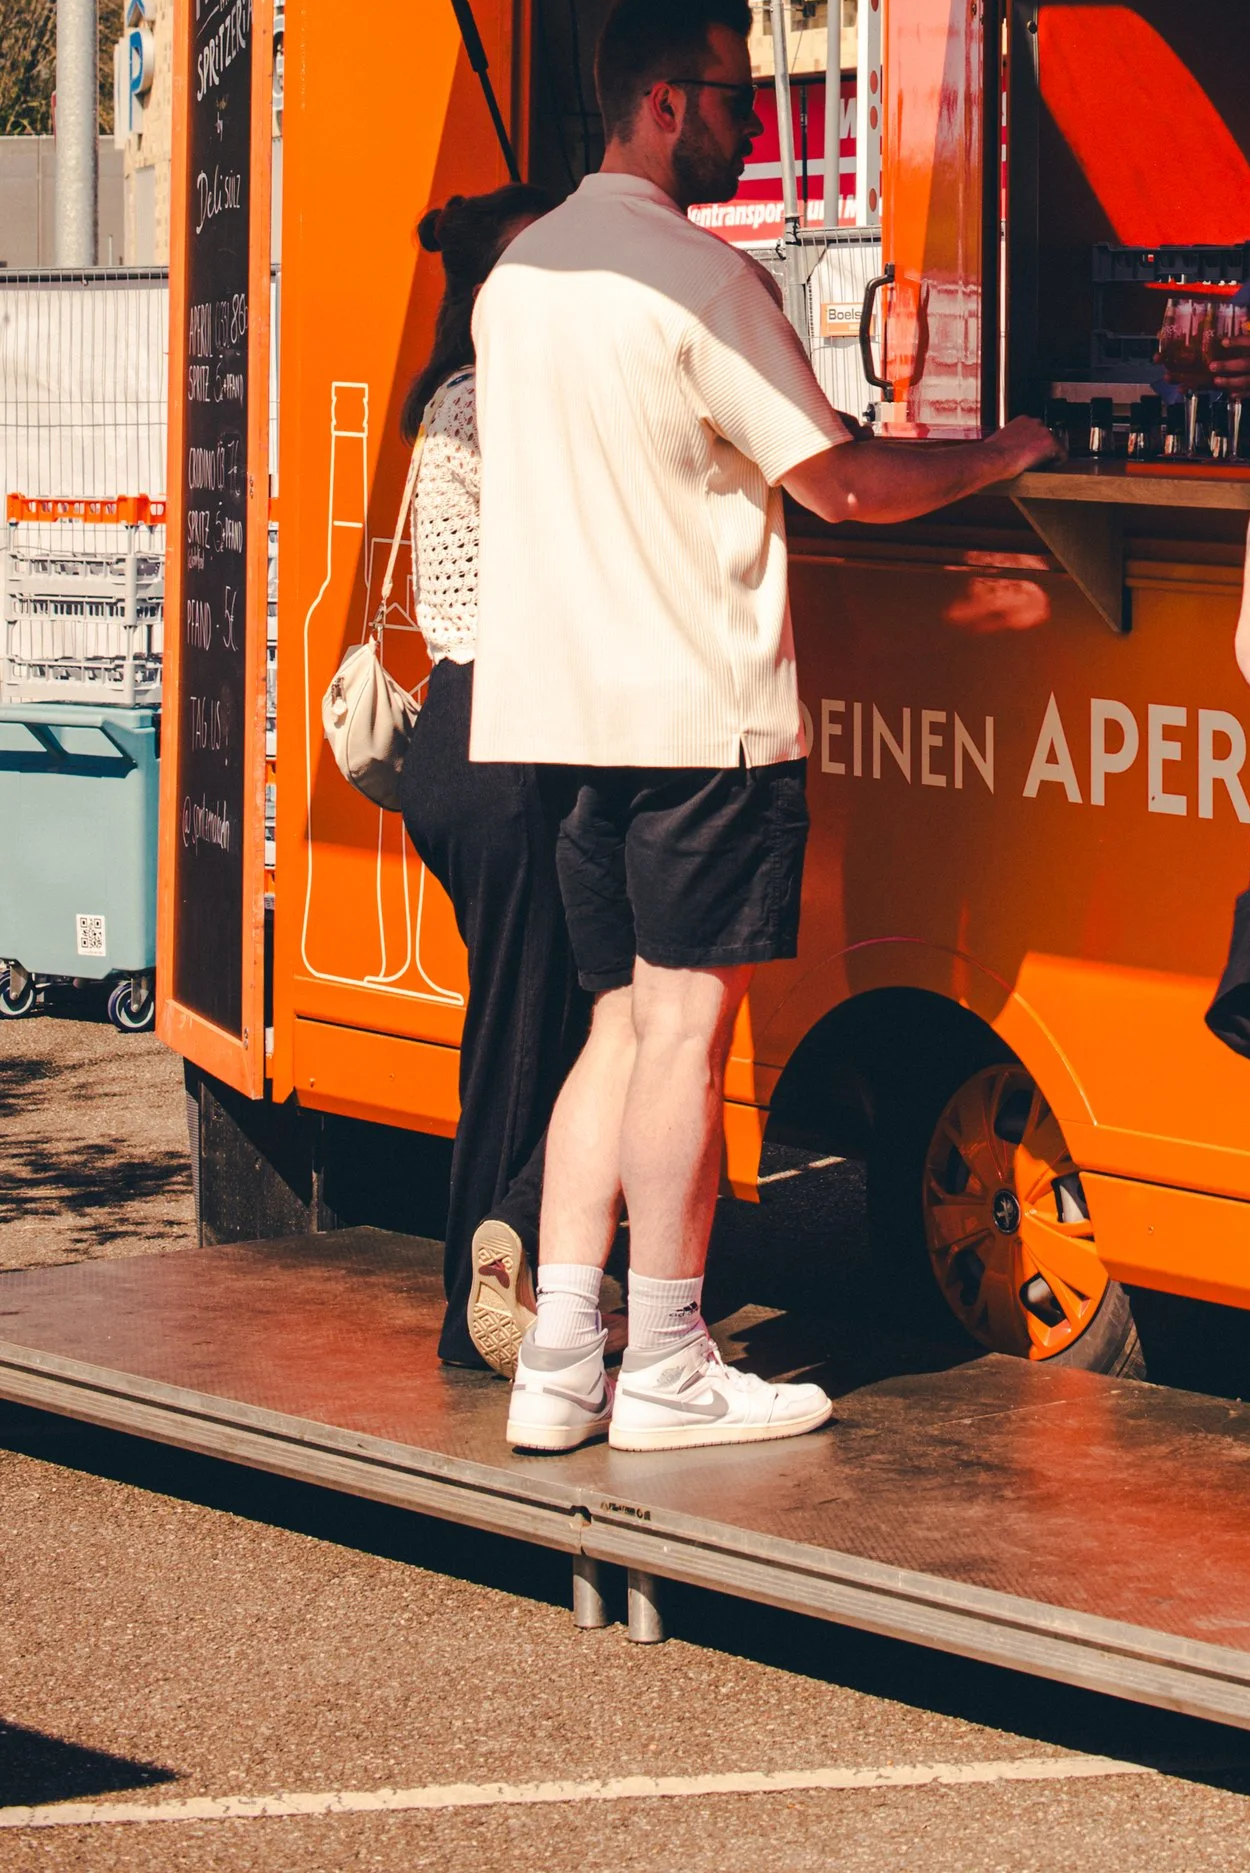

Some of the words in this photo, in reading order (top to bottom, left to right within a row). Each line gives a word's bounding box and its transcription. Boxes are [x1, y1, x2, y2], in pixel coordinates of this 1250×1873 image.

[196, 164, 222, 236] Deli
[188, 301, 213, 357] APEROL
[828, 308, 862, 321] Boels
[187, 599, 212, 652] PFAND
[190, 695, 208, 752] TAG
